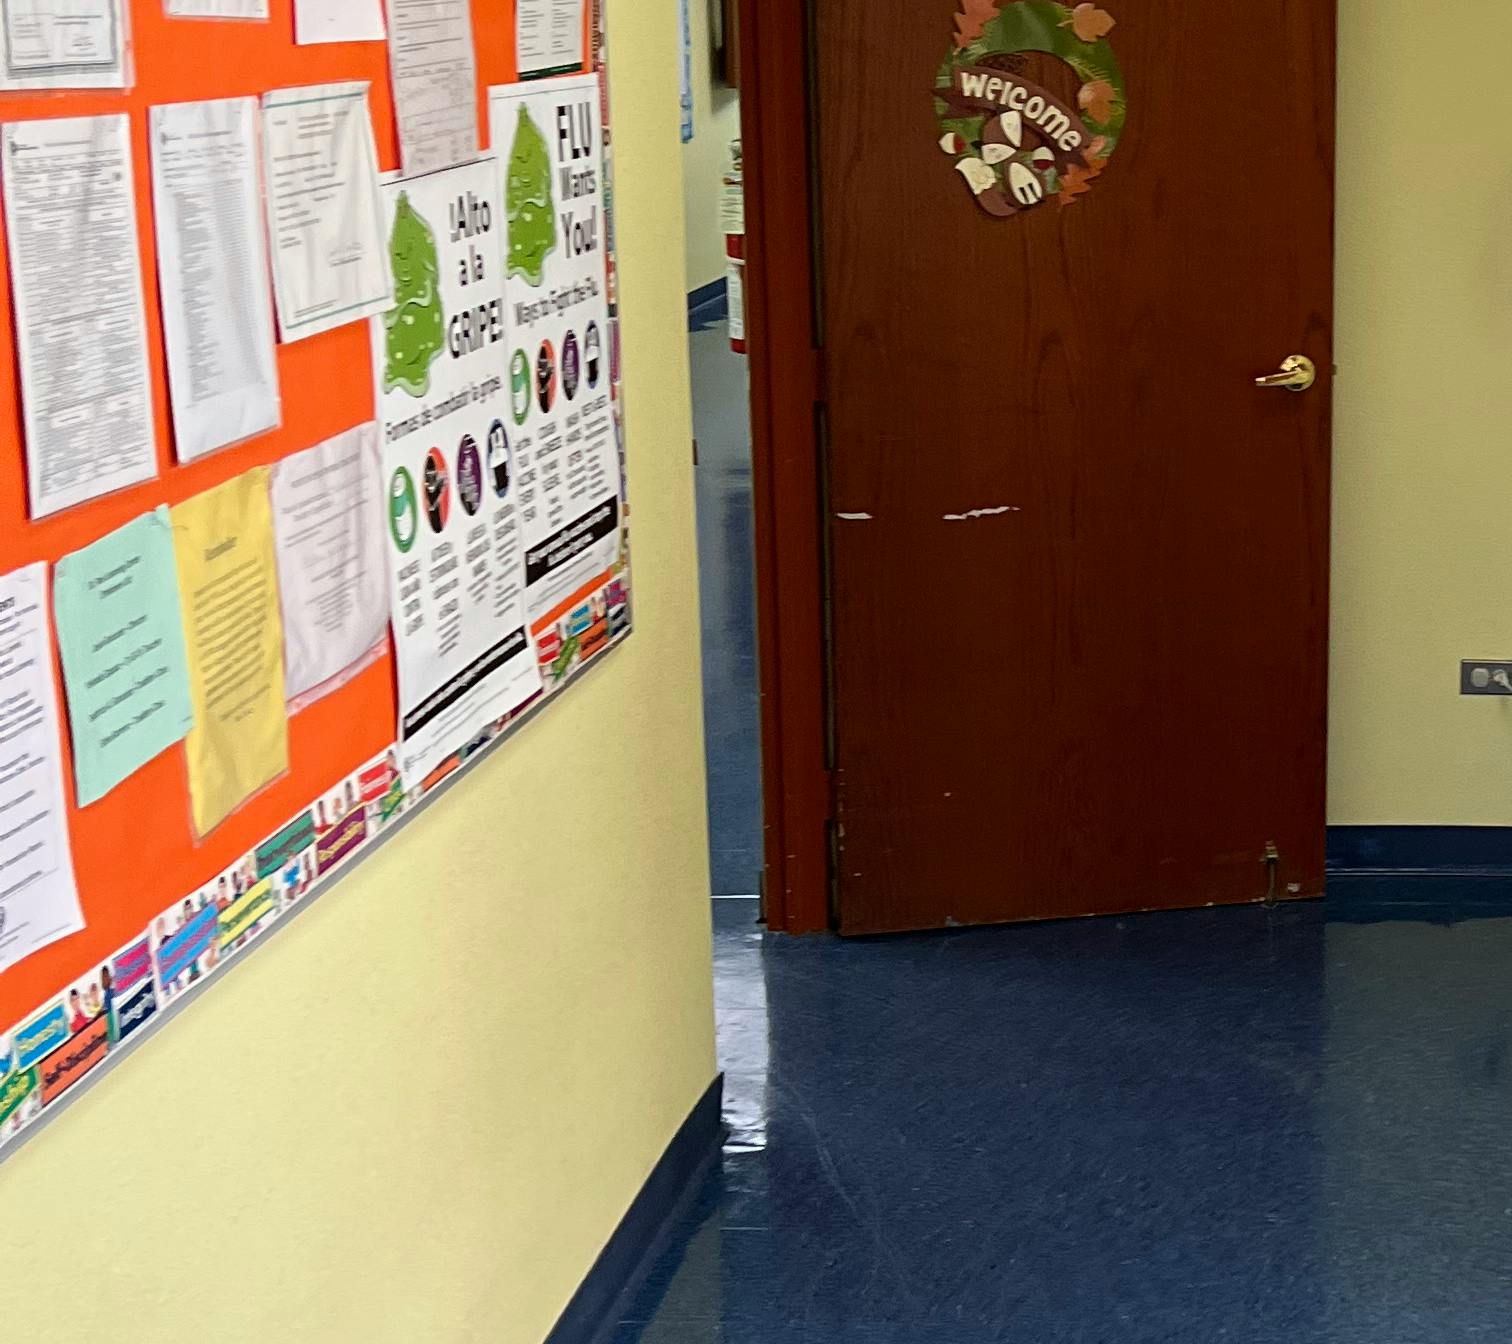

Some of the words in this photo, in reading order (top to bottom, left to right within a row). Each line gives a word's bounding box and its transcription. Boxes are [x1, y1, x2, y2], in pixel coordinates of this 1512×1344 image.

[557, 102, 592, 162] FLU
[560, 205, 598, 259] You!
[459, 259, 469, 288] a
[469, 244, 485, 283] la
[448, 297, 504, 360] GRIPE!
